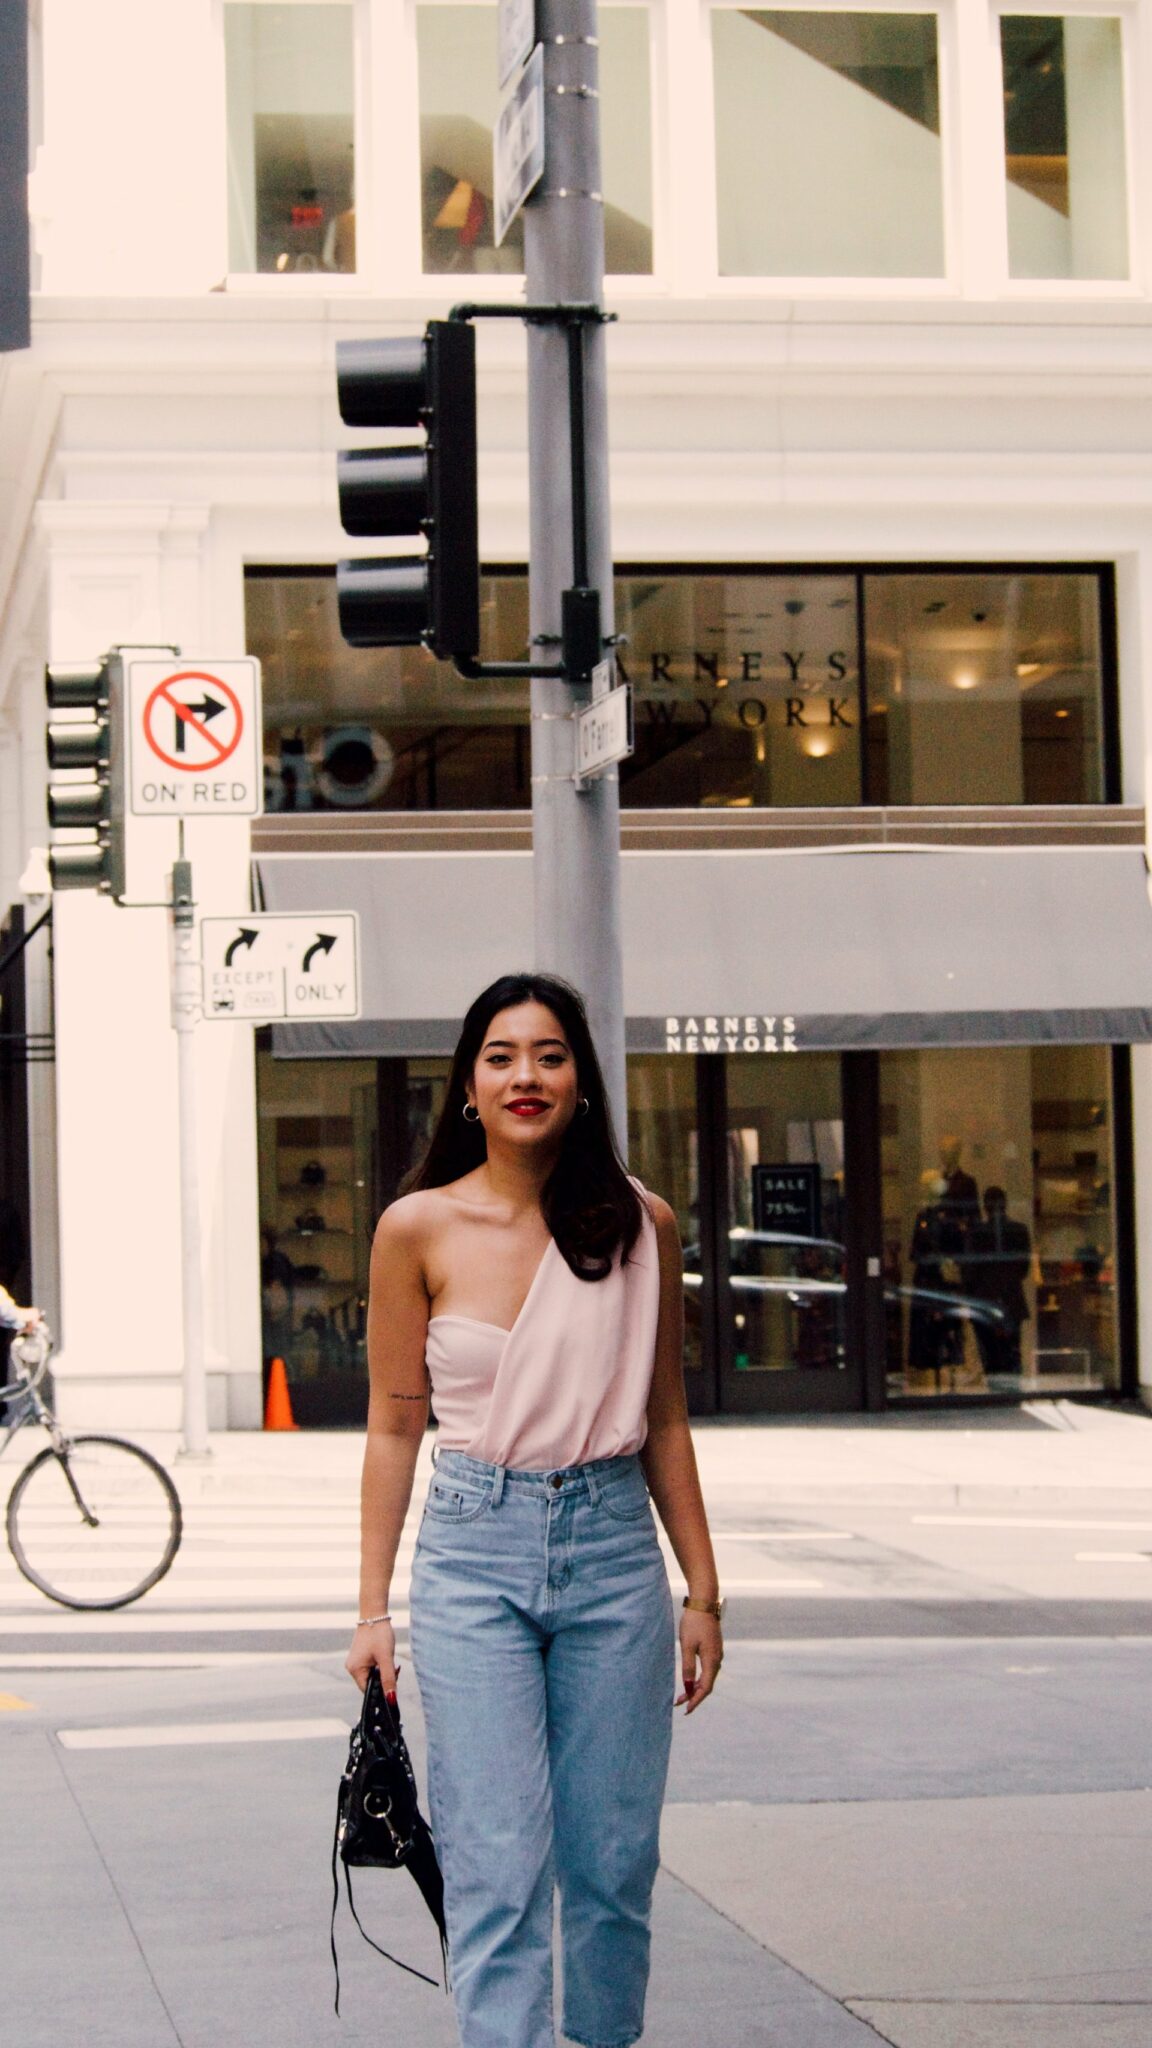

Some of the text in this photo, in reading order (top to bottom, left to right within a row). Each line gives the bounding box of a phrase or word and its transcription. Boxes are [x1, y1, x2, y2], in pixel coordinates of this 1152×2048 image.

[615, 652, 848, 682] ARNEYS
[645, 698, 852, 728] WYORK
[142, 782, 247, 802] ON RED
[212, 971, 274, 985] EXCEPT
[295, 983, 346, 1001] ONLY
[666, 1016, 796, 1034] BARNEYS
[765, 1179, 806, 1191] SALE
